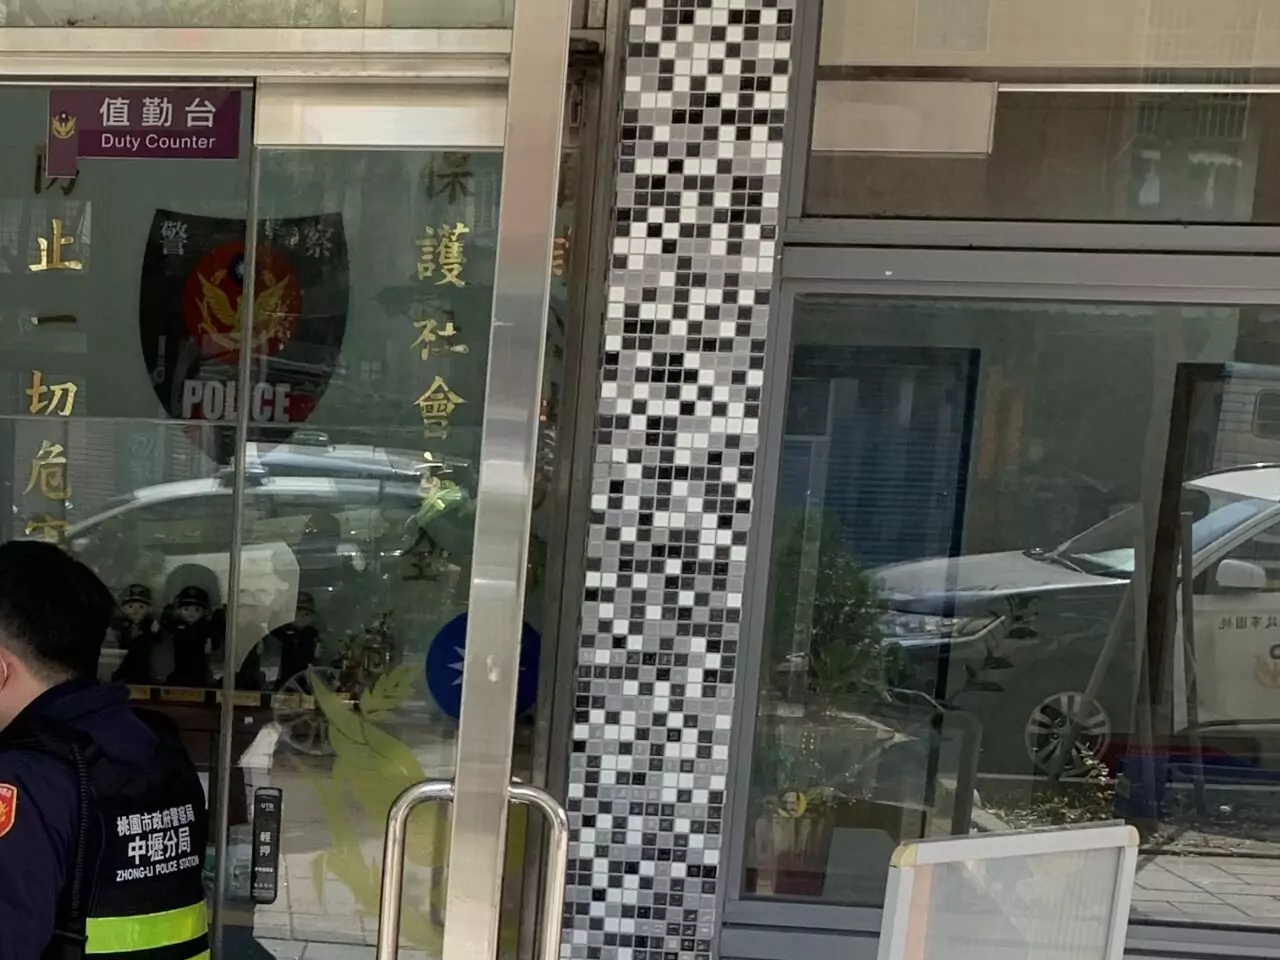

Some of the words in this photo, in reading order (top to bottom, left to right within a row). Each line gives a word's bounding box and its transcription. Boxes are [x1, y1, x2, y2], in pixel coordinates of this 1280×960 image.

[99, 97, 217, 128] 值勤台
[101, 133, 141, 151] Duty
[145, 133, 217, 149] Counter
[181, 379, 293, 423] POLCE
[116, 803, 196, 837] 桃園市政府警察局
[127, 825, 192, 866] 中壢分局
[115, 865, 154, 882] ZHONG-LI
[155, 860, 179, 876] POLICE
